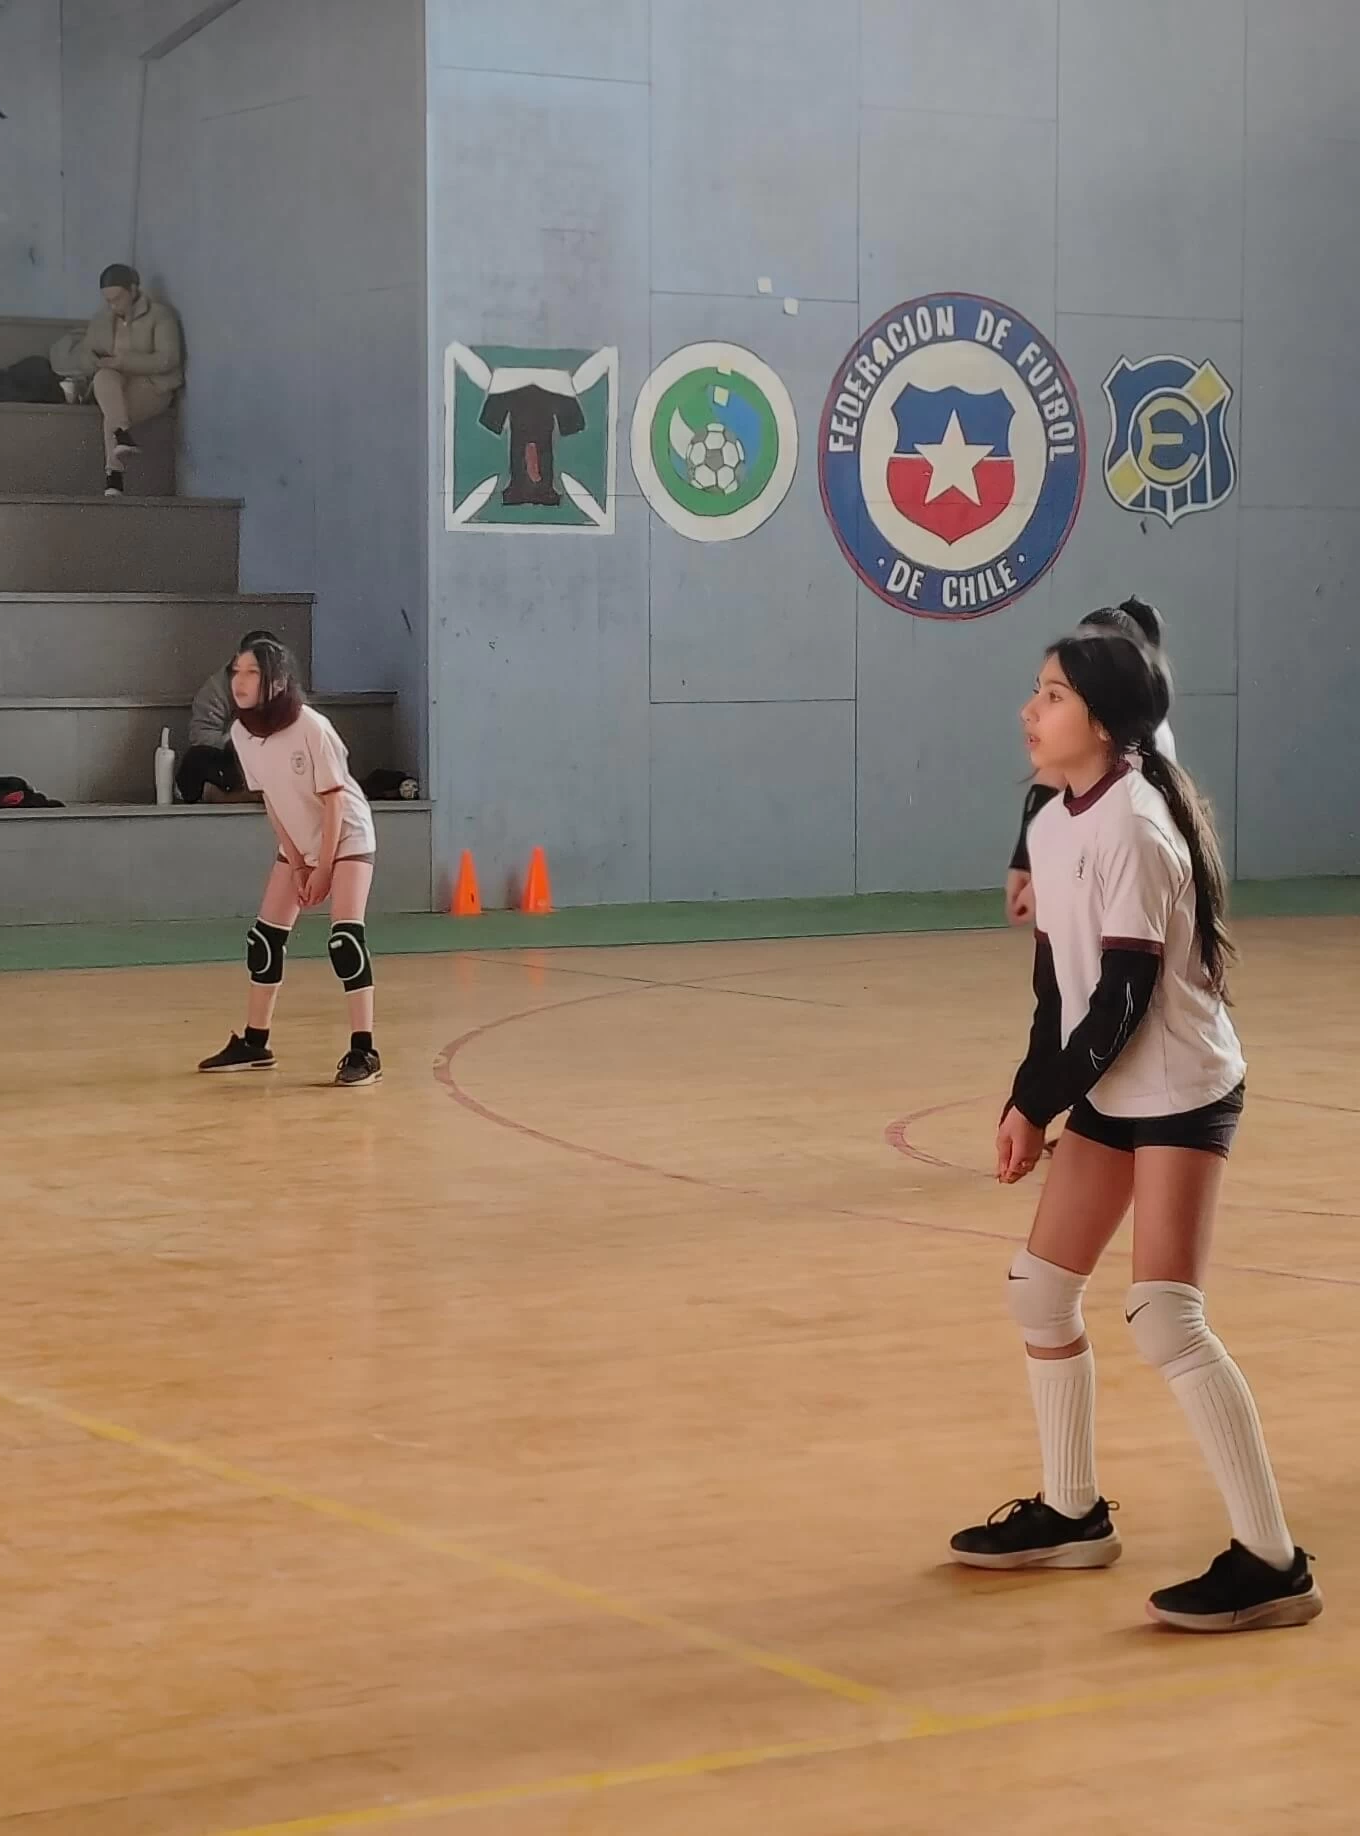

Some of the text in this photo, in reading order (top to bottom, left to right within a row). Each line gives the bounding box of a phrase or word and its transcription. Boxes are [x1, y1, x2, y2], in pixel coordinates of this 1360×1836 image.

[828, 304, 1076, 462] FEDERACION DE FUTBOL
[886, 558, 1018, 608] DE CHILE
